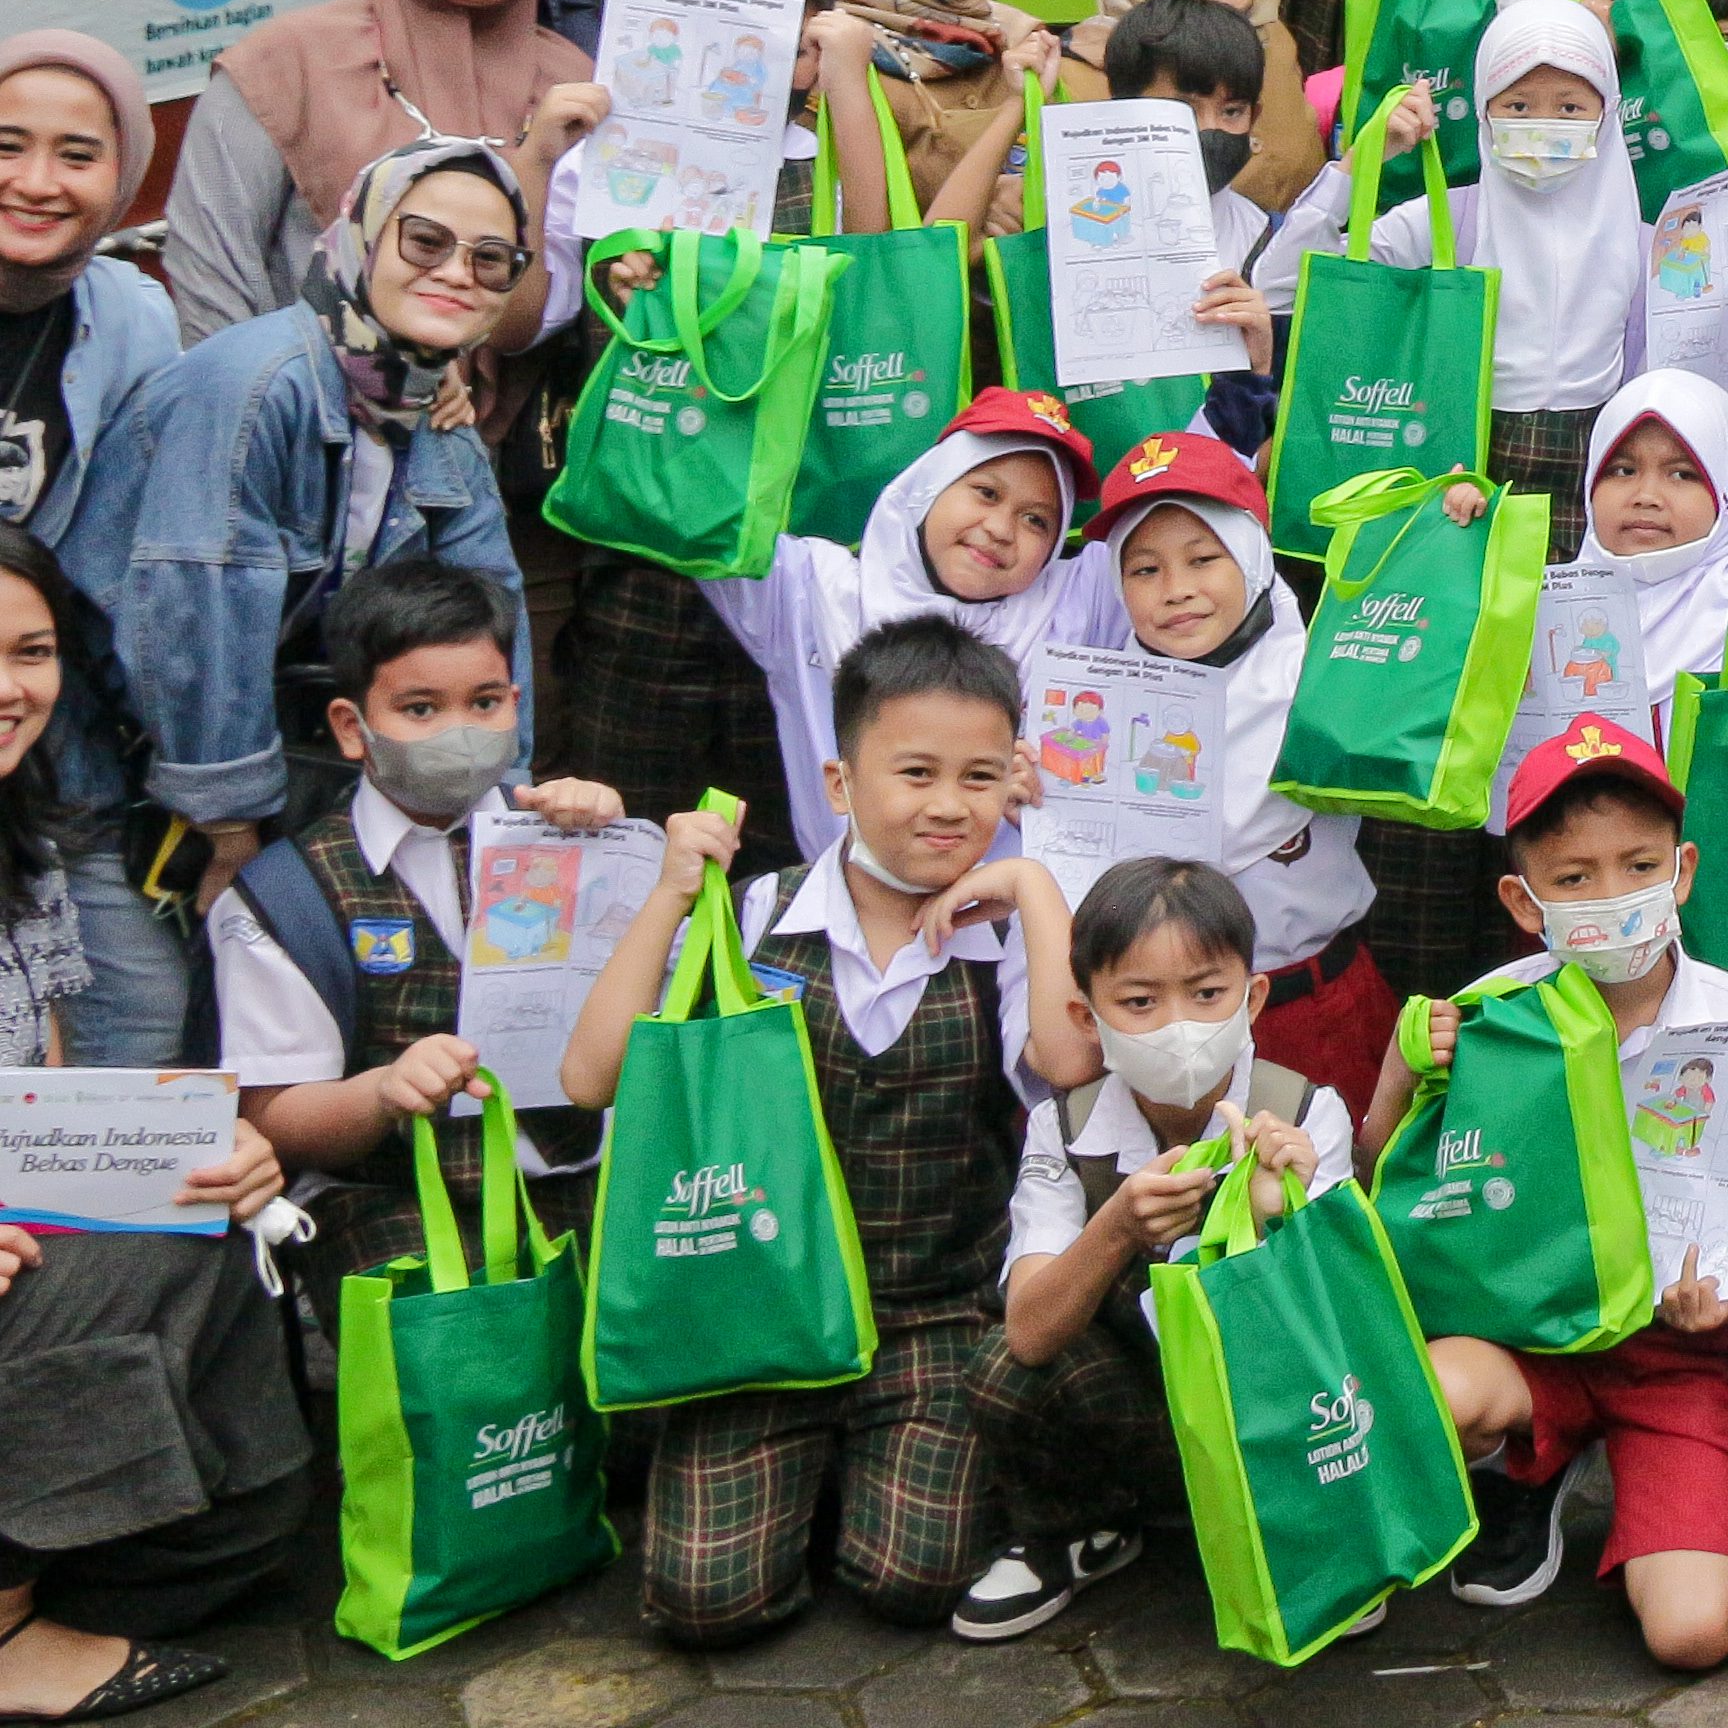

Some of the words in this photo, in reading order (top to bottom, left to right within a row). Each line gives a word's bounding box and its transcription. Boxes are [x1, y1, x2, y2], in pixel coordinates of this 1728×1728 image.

[828, 352, 904, 393] Soffell
[1340, 375, 1415, 413] Soffell
[0, 1128, 97, 1149] ujudkan
[105, 1127, 217, 1147] Indonesia
[1435, 1129, 1482, 1180] ffell
[21, 1153, 87, 1173] Bebas
[95, 1153, 178, 1176] Dengue
[665, 1162, 748, 1218] Soffell
[474, 1402, 564, 1461] Soffell
